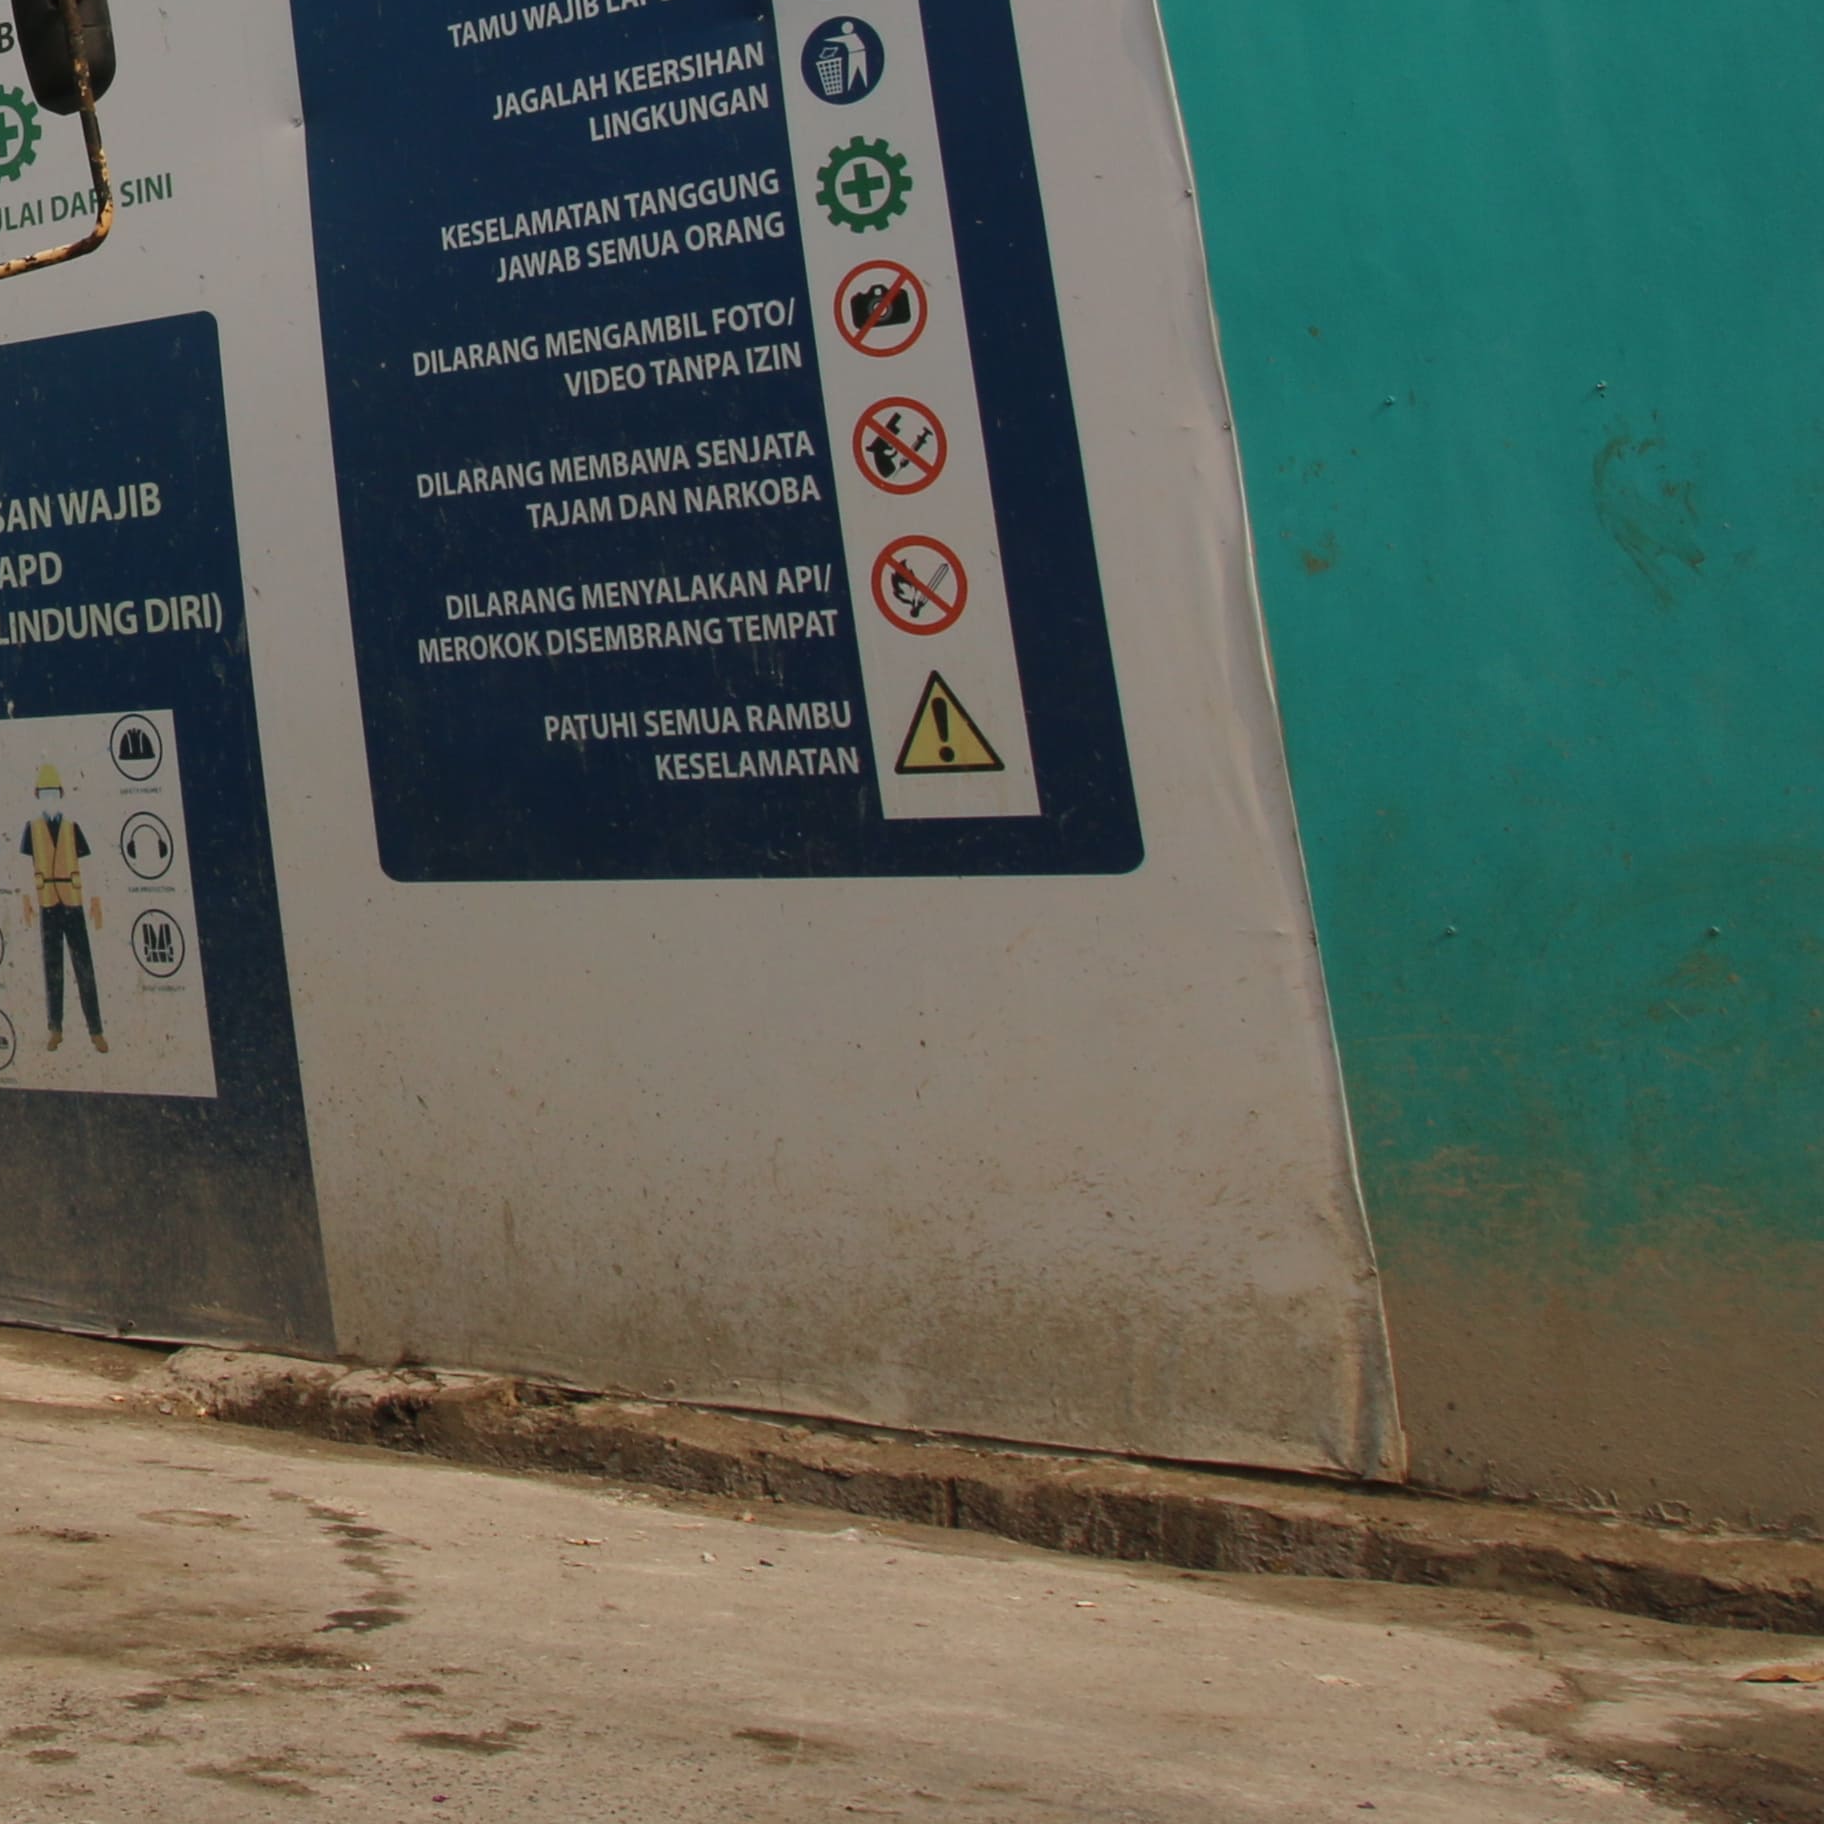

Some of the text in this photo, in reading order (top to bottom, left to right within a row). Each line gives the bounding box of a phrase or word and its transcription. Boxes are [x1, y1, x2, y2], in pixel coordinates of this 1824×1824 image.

[448, 11, 517, 47] TAMU
[494, 42, 763, 120] JAGALAH KEERSIHAN
[590, 84, 768, 141] LINGKUNGAN
[120, 172, 172, 208] SINI
[442, 169, 779, 250] KESELAMATAN TANGGUNG
[497, 212, 784, 282] JAWAB SEMUA ORANG
[413, 298, 794, 376] DILARANG MENGAMBIL FOTO/
[565, 342, 801, 396] VIDEO TANPA IZIN
[417, 431, 814, 498] DILARANG MEMBAWA SENJATA
[58, 483, 161, 525] WAJIB
[526, 475, 820, 528] TAJAM DAN NARKOBA
[145, 593, 222, 632] DIRI)
[446, 564, 830, 619] DILARANG MENYALAKAN API/
[419, 610, 837, 663] MEROKOK DISEMBRANG TEMPAT
[545, 701, 851, 741] PATUHI SEMUA RAMBU
[656, 747, 858, 780] KESELAMATAN
